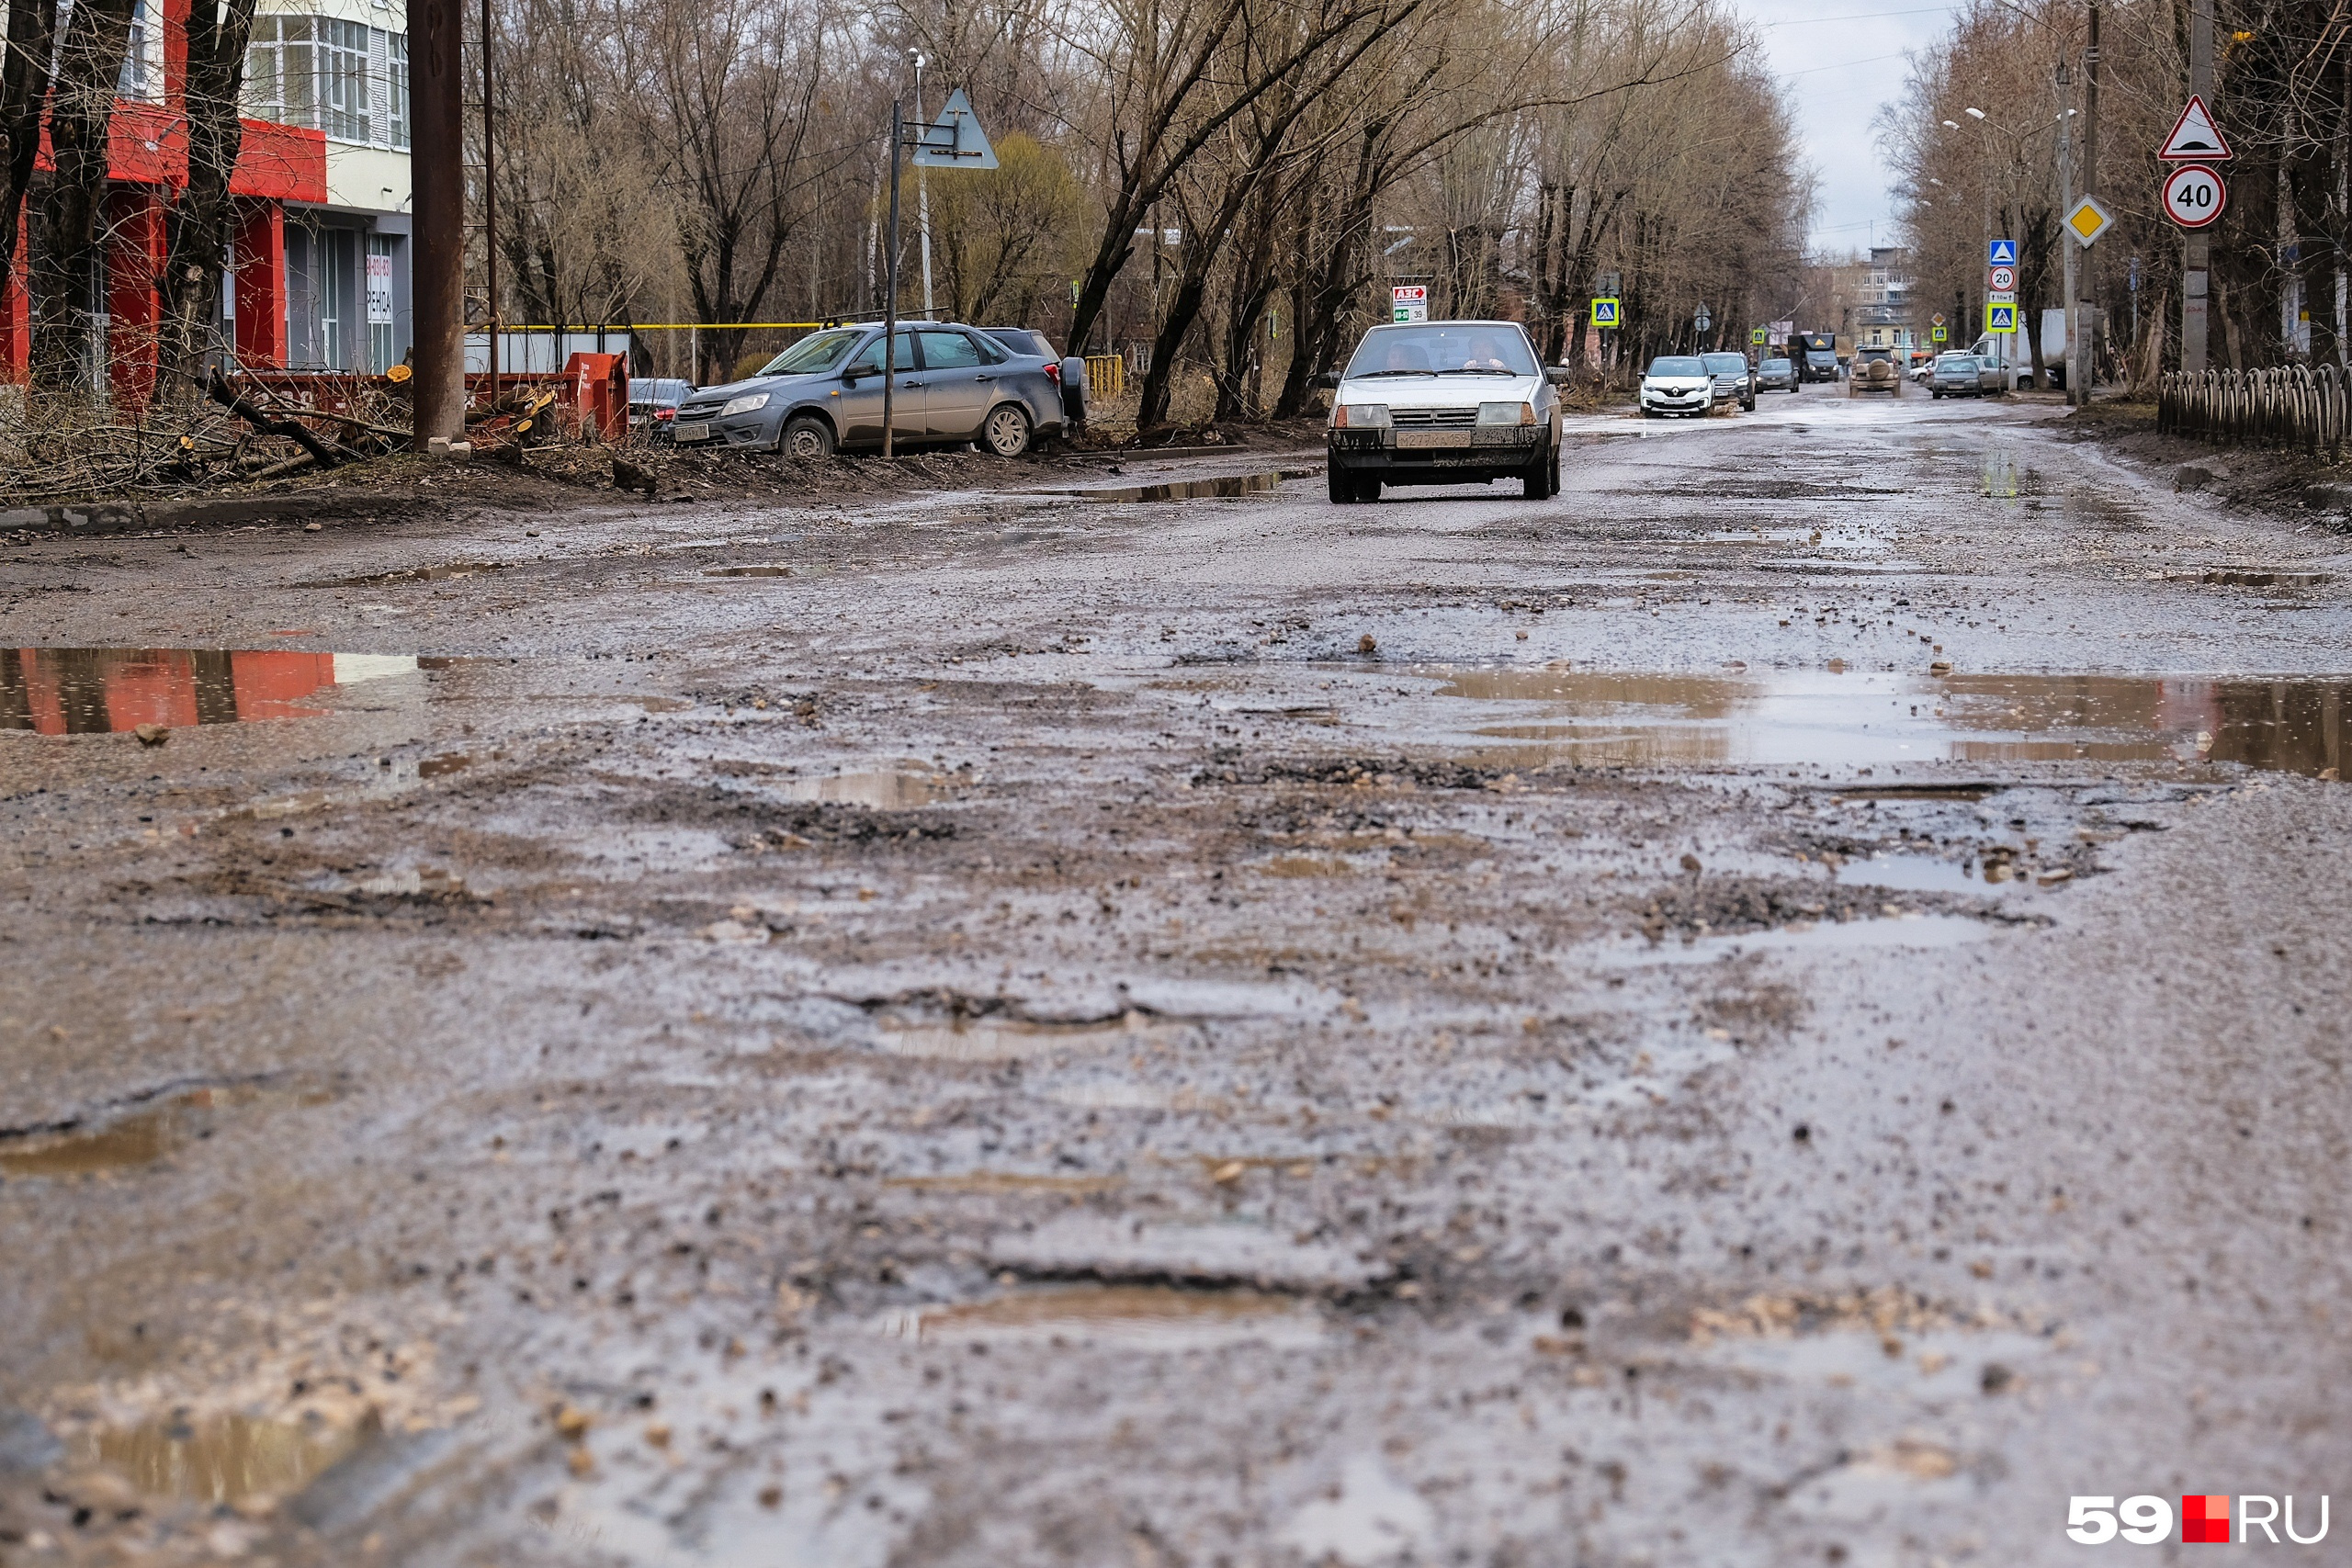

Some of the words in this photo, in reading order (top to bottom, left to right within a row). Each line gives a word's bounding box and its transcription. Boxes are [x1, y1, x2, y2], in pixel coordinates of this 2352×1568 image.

[2177, 184, 2211, 208] 40
[1996, 273, 2010, 283] 20
[1396, 288, 1419, 299] АЗС
[1413, 310, 1422, 319] 39
